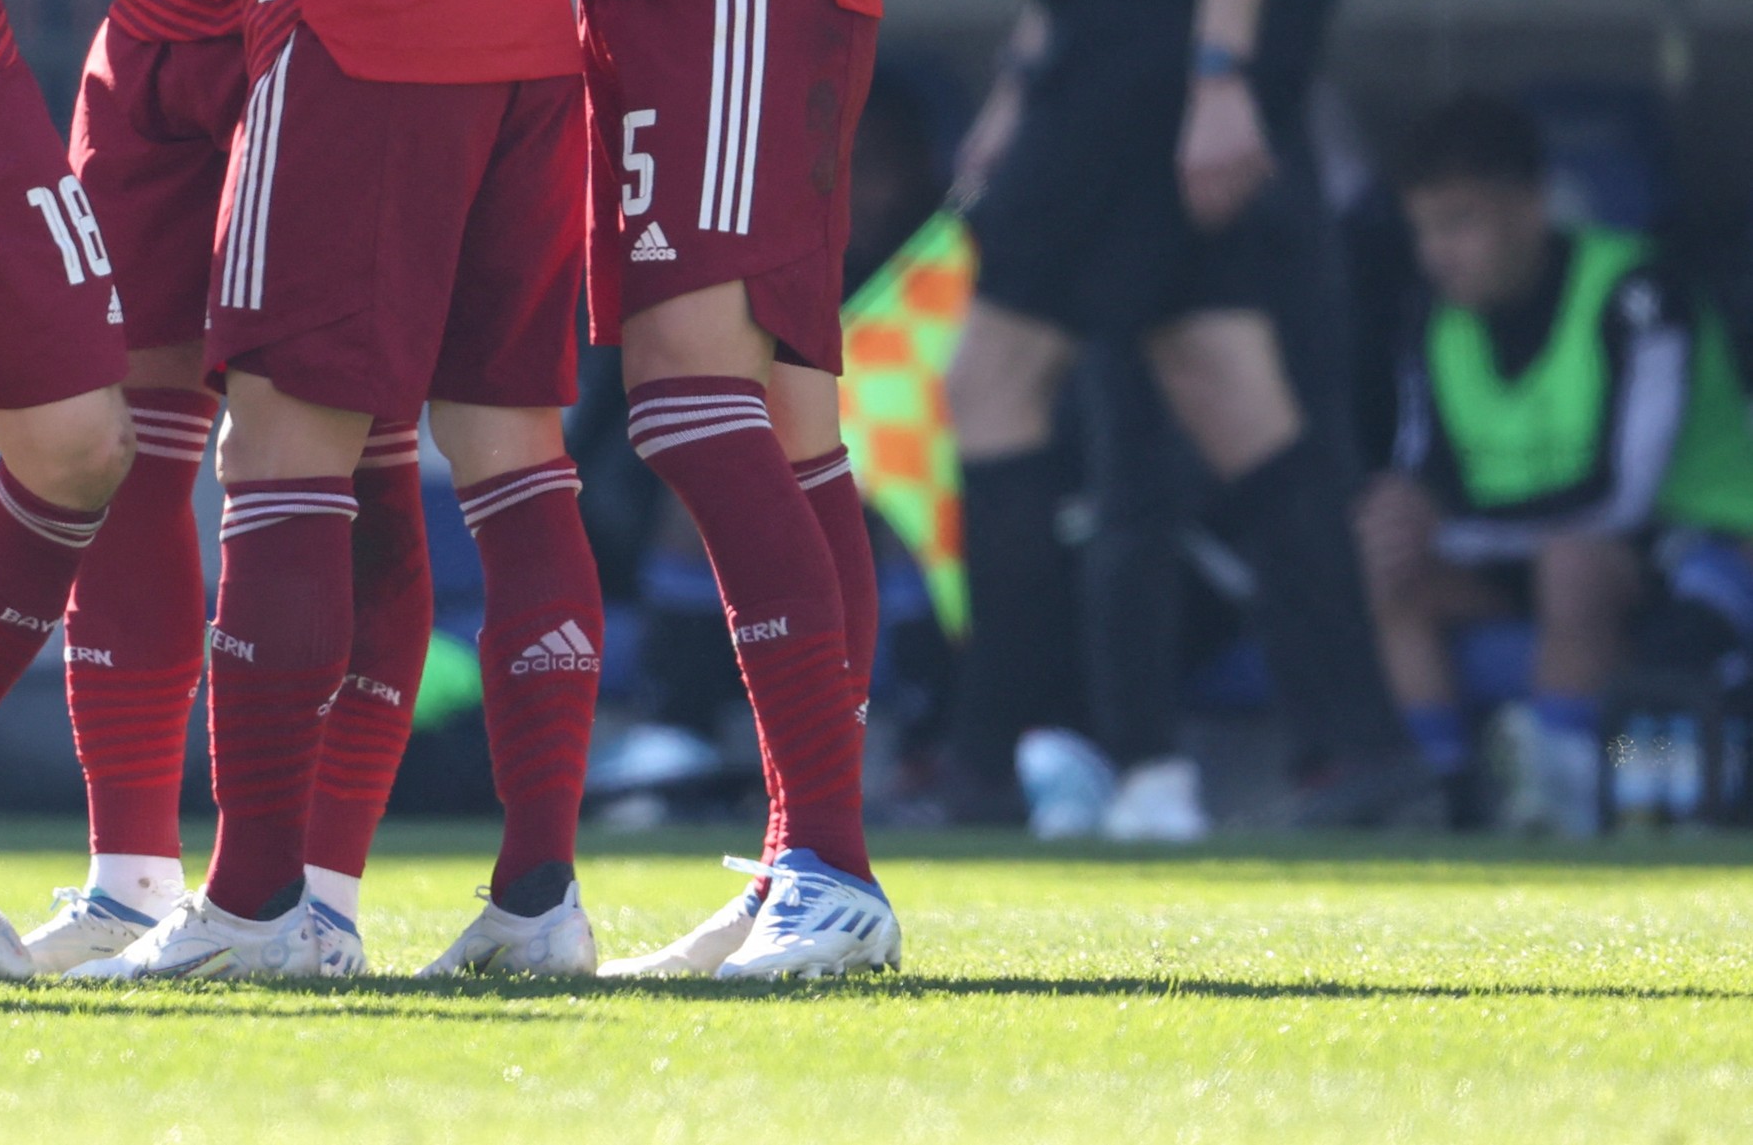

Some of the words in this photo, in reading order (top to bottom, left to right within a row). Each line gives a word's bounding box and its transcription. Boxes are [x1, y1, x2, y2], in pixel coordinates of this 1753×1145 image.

[622, 109, 656, 216] 5
[26, 174, 112, 285] 18
[631, 246, 677, 262] adidas
[0, 607, 58, 633] BAY
[511, 651, 601, 674] adidas
